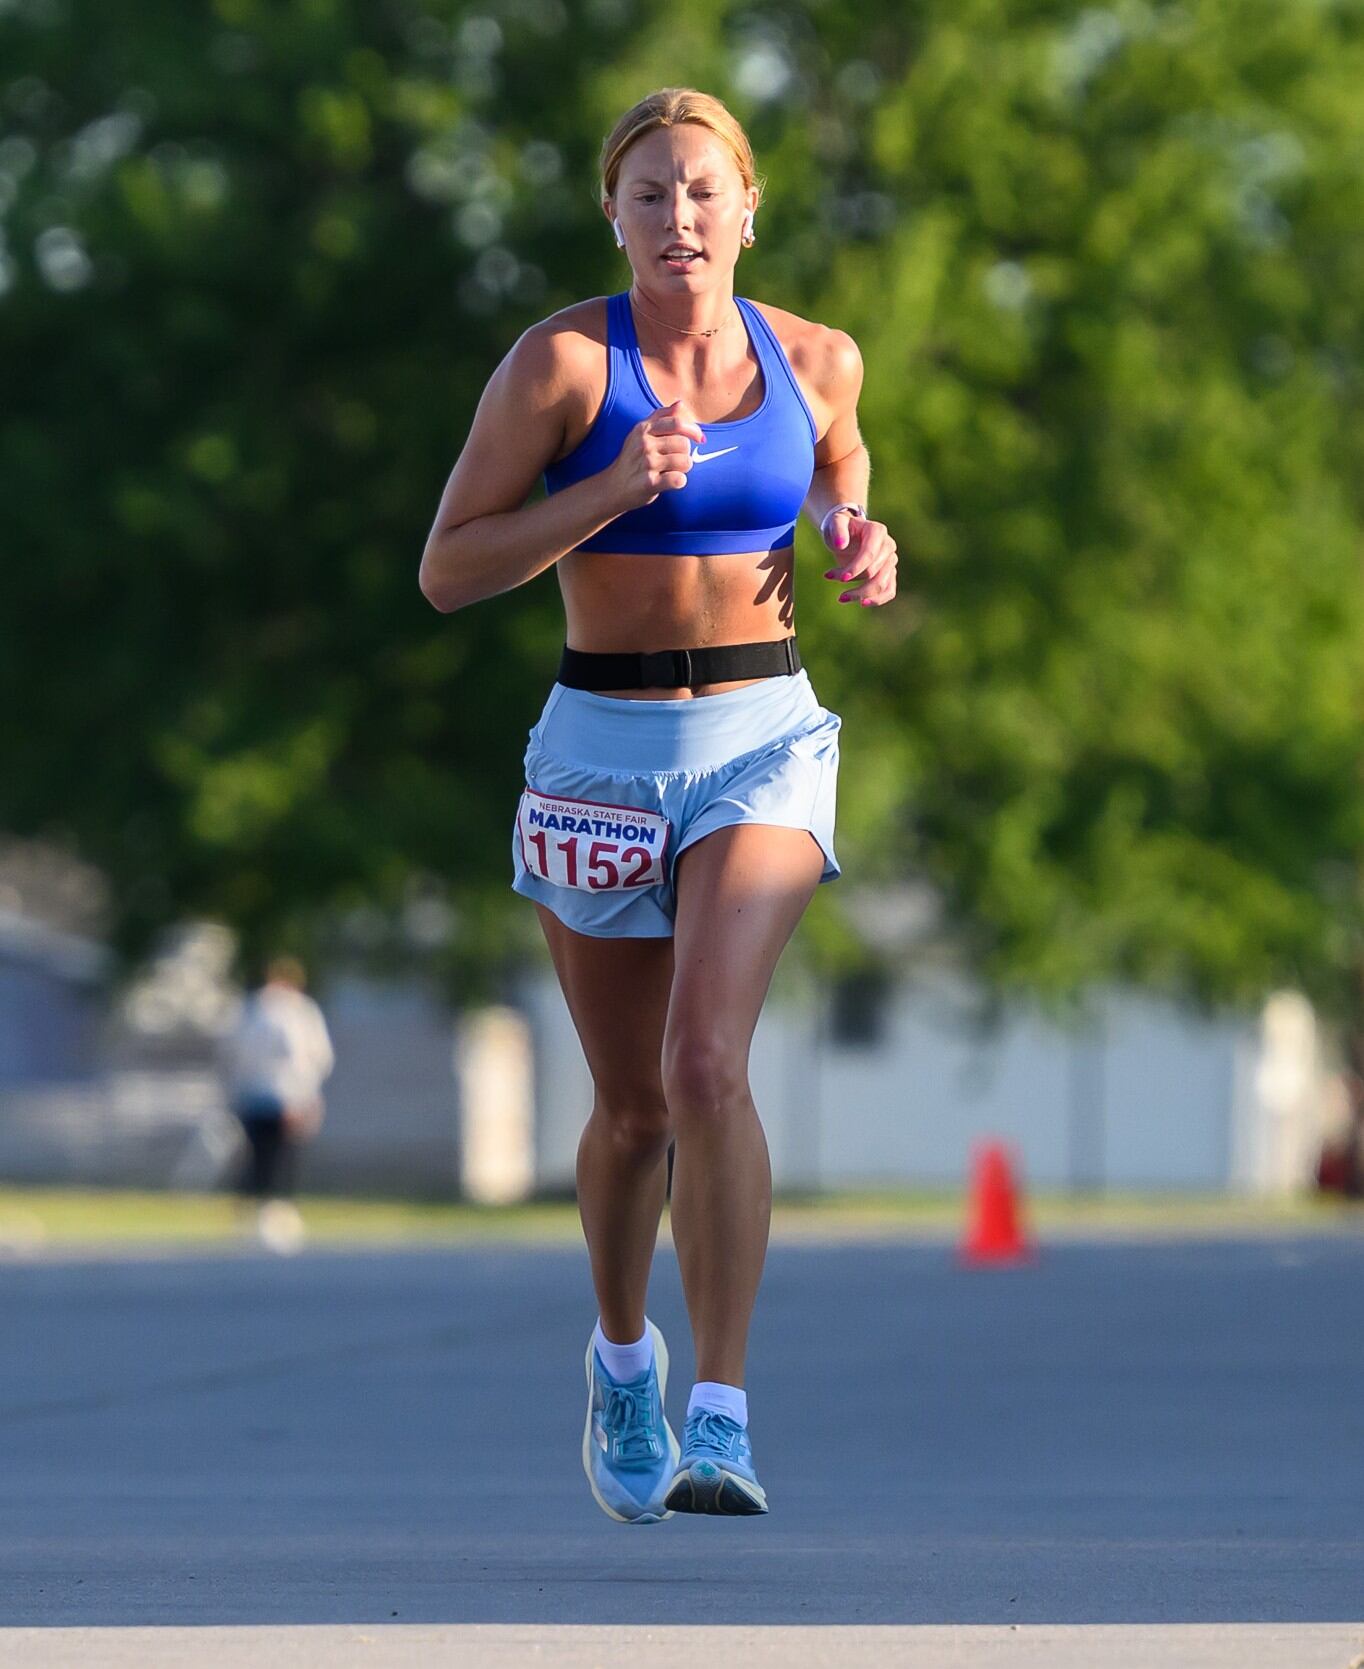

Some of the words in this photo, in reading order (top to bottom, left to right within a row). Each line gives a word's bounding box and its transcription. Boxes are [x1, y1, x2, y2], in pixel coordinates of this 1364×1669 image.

[529, 808, 656, 844] MARATHON
[539, 802, 590, 817] NEBRASKA
[593, 810, 622, 822] STATE
[624, 815, 647, 825] FAIR
[528, 831, 656, 890] 1152
